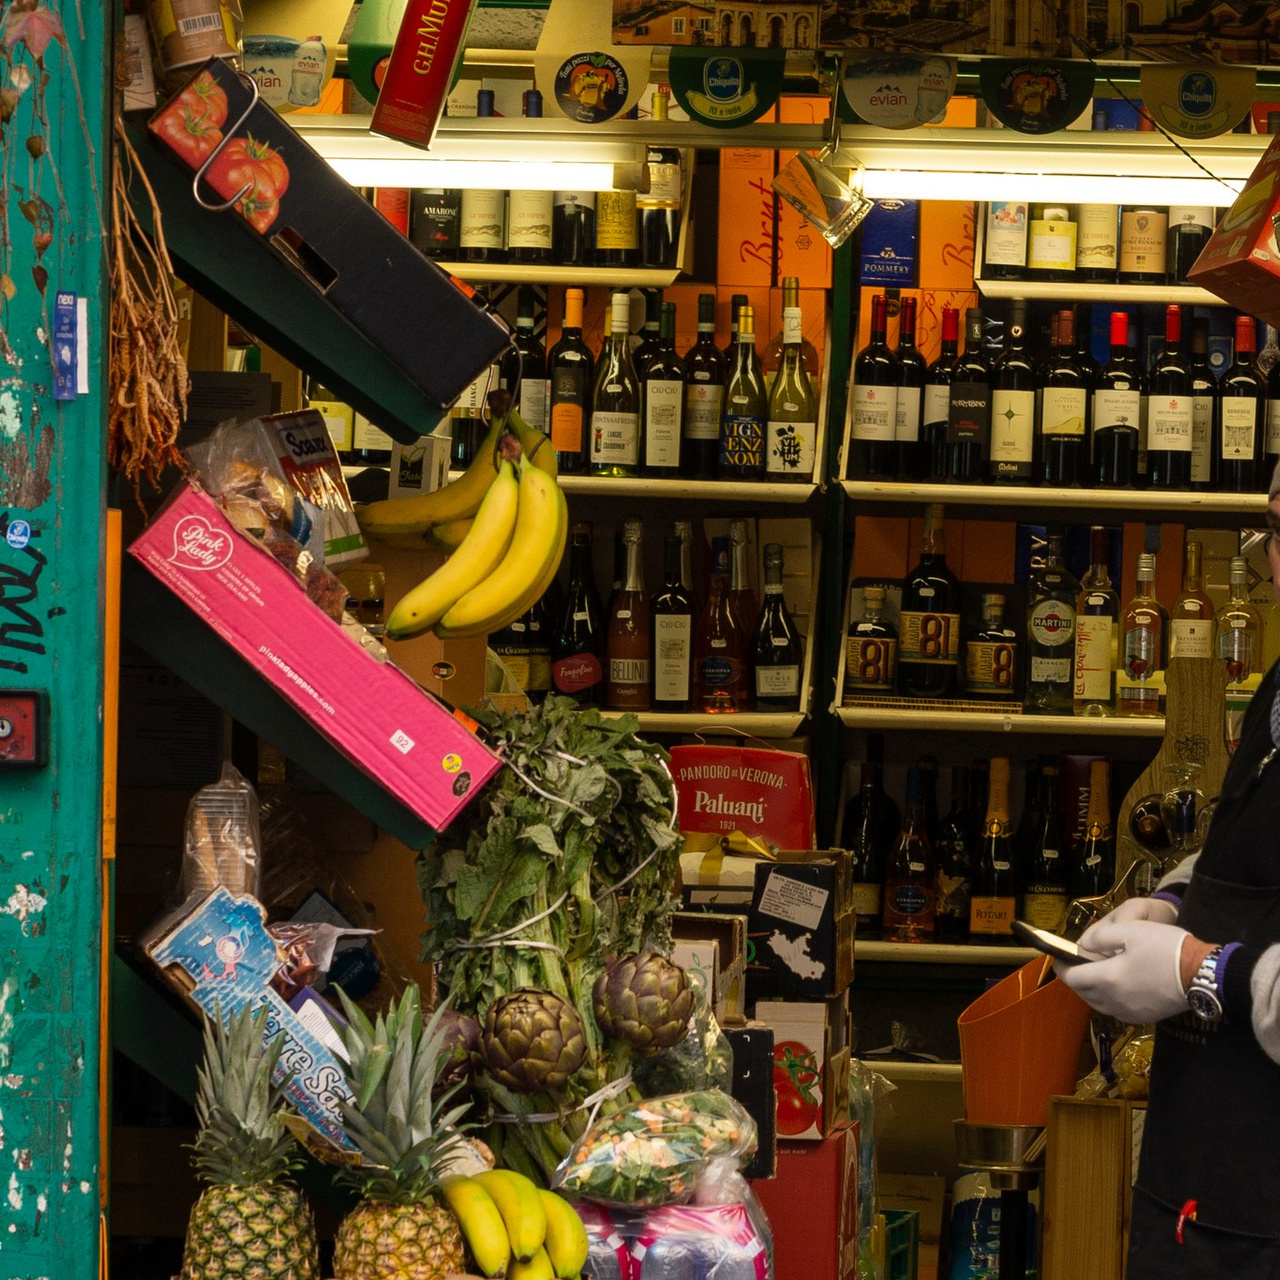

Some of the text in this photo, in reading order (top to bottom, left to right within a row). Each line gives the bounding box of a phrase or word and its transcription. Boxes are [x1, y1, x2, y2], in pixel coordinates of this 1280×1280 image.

[254, 75, 281, 88] vian
[709, 76, 740, 87] Chiquita
[923, 78, 944, 86] evian
[869, 94, 907, 106] evian
[1182, 92, 1212, 103] Chiquita
[864, 263, 910, 275] POMMERY
[181, 523, 226, 552] Pink
[178, 539, 218, 564] Lady
[1033, 616, 1071, 629] MARTINI
[911, 613, 950, 659] AMARO 81
[859, 639, 890, 684] 81
[985, 646, 994, 689] AMARO
[612, 661, 649, 681] BELLINI
[258, 644, 336, 716] pinkladyapples.com
[395, 734, 410, 749] 92
[680, 764, 785, 790] PANDORO VERONA
[693, 789, 765, 825] Paluani
[720, 820, 736, 831] 1921
[975, 910, 1007, 920] ROTARI
